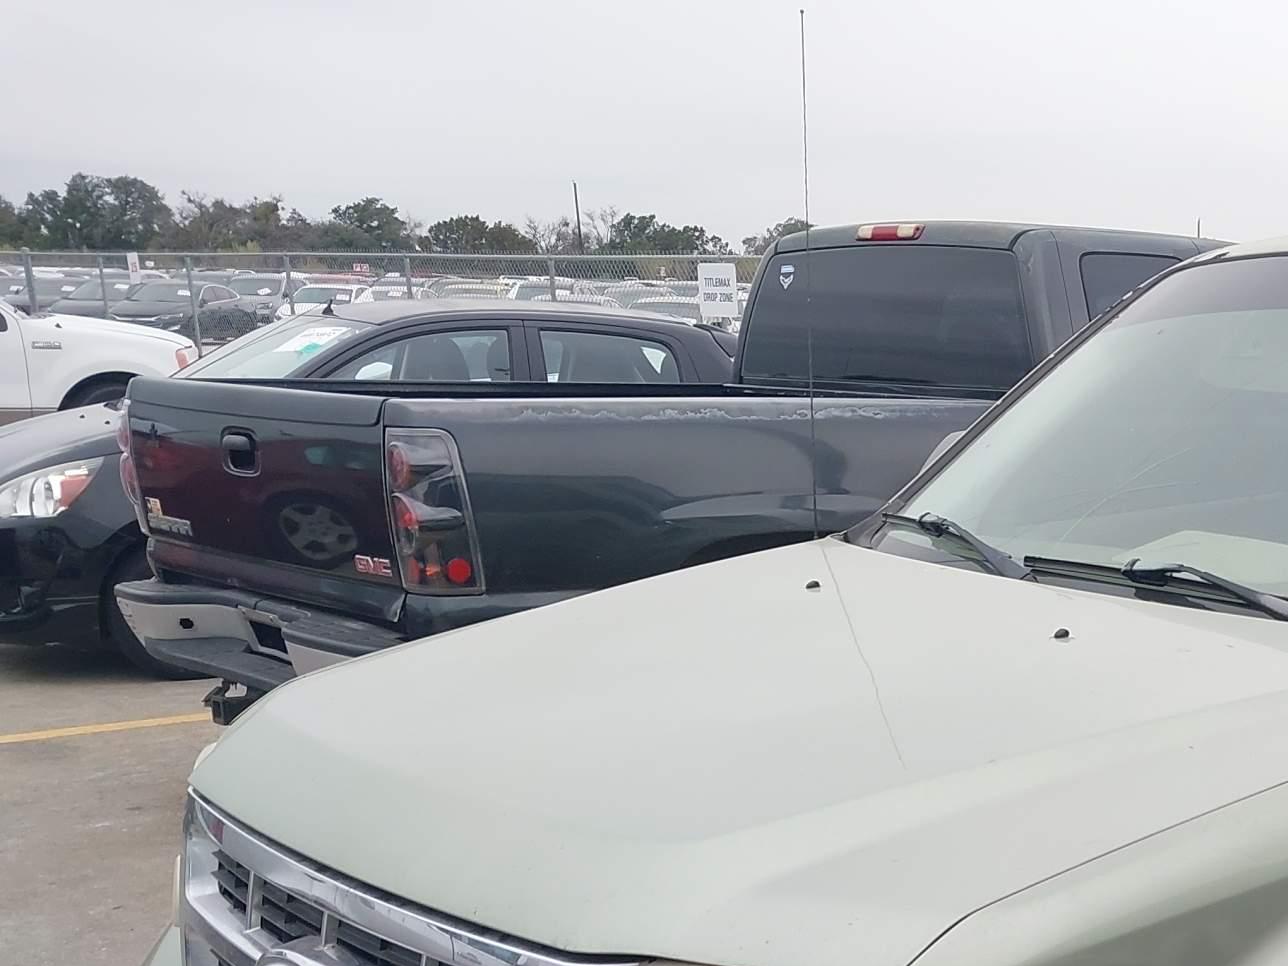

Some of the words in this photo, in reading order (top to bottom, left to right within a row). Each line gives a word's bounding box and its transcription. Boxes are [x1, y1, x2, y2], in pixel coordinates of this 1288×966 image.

[703, 277, 731, 288] TITLEMAX
[703, 292, 718, 302] DROP
[719, 292, 734, 303] ZONE
